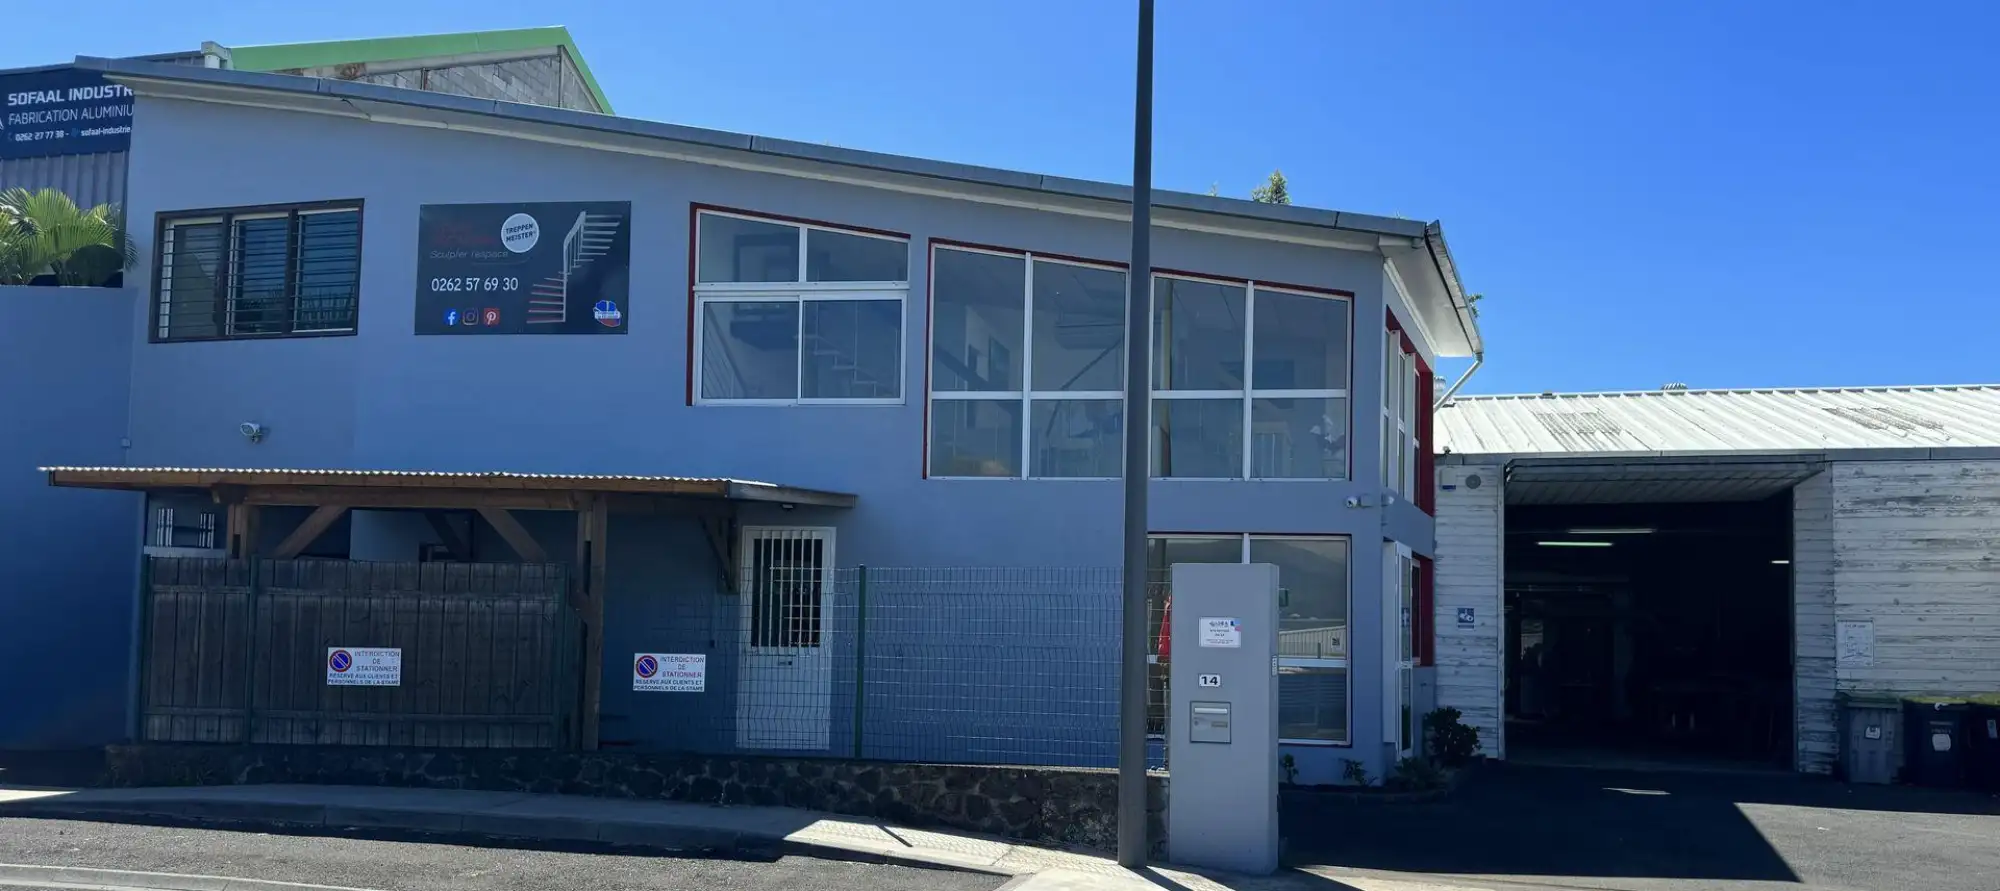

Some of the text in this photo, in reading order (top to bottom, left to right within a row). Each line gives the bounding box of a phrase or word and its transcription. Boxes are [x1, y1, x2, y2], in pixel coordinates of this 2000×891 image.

[8, 90, 65, 106] SOFAAL
[8, 109, 79, 125] FABRICATION
[15, 133, 33, 142] 0262
[34, 131, 44, 141] 27
[45, 131, 54, 140] 77
[505, 223, 534, 235] TREPPEN
[431, 277, 519, 292] 0262 57 69 30
[1201, 676, 1218, 685] 14
